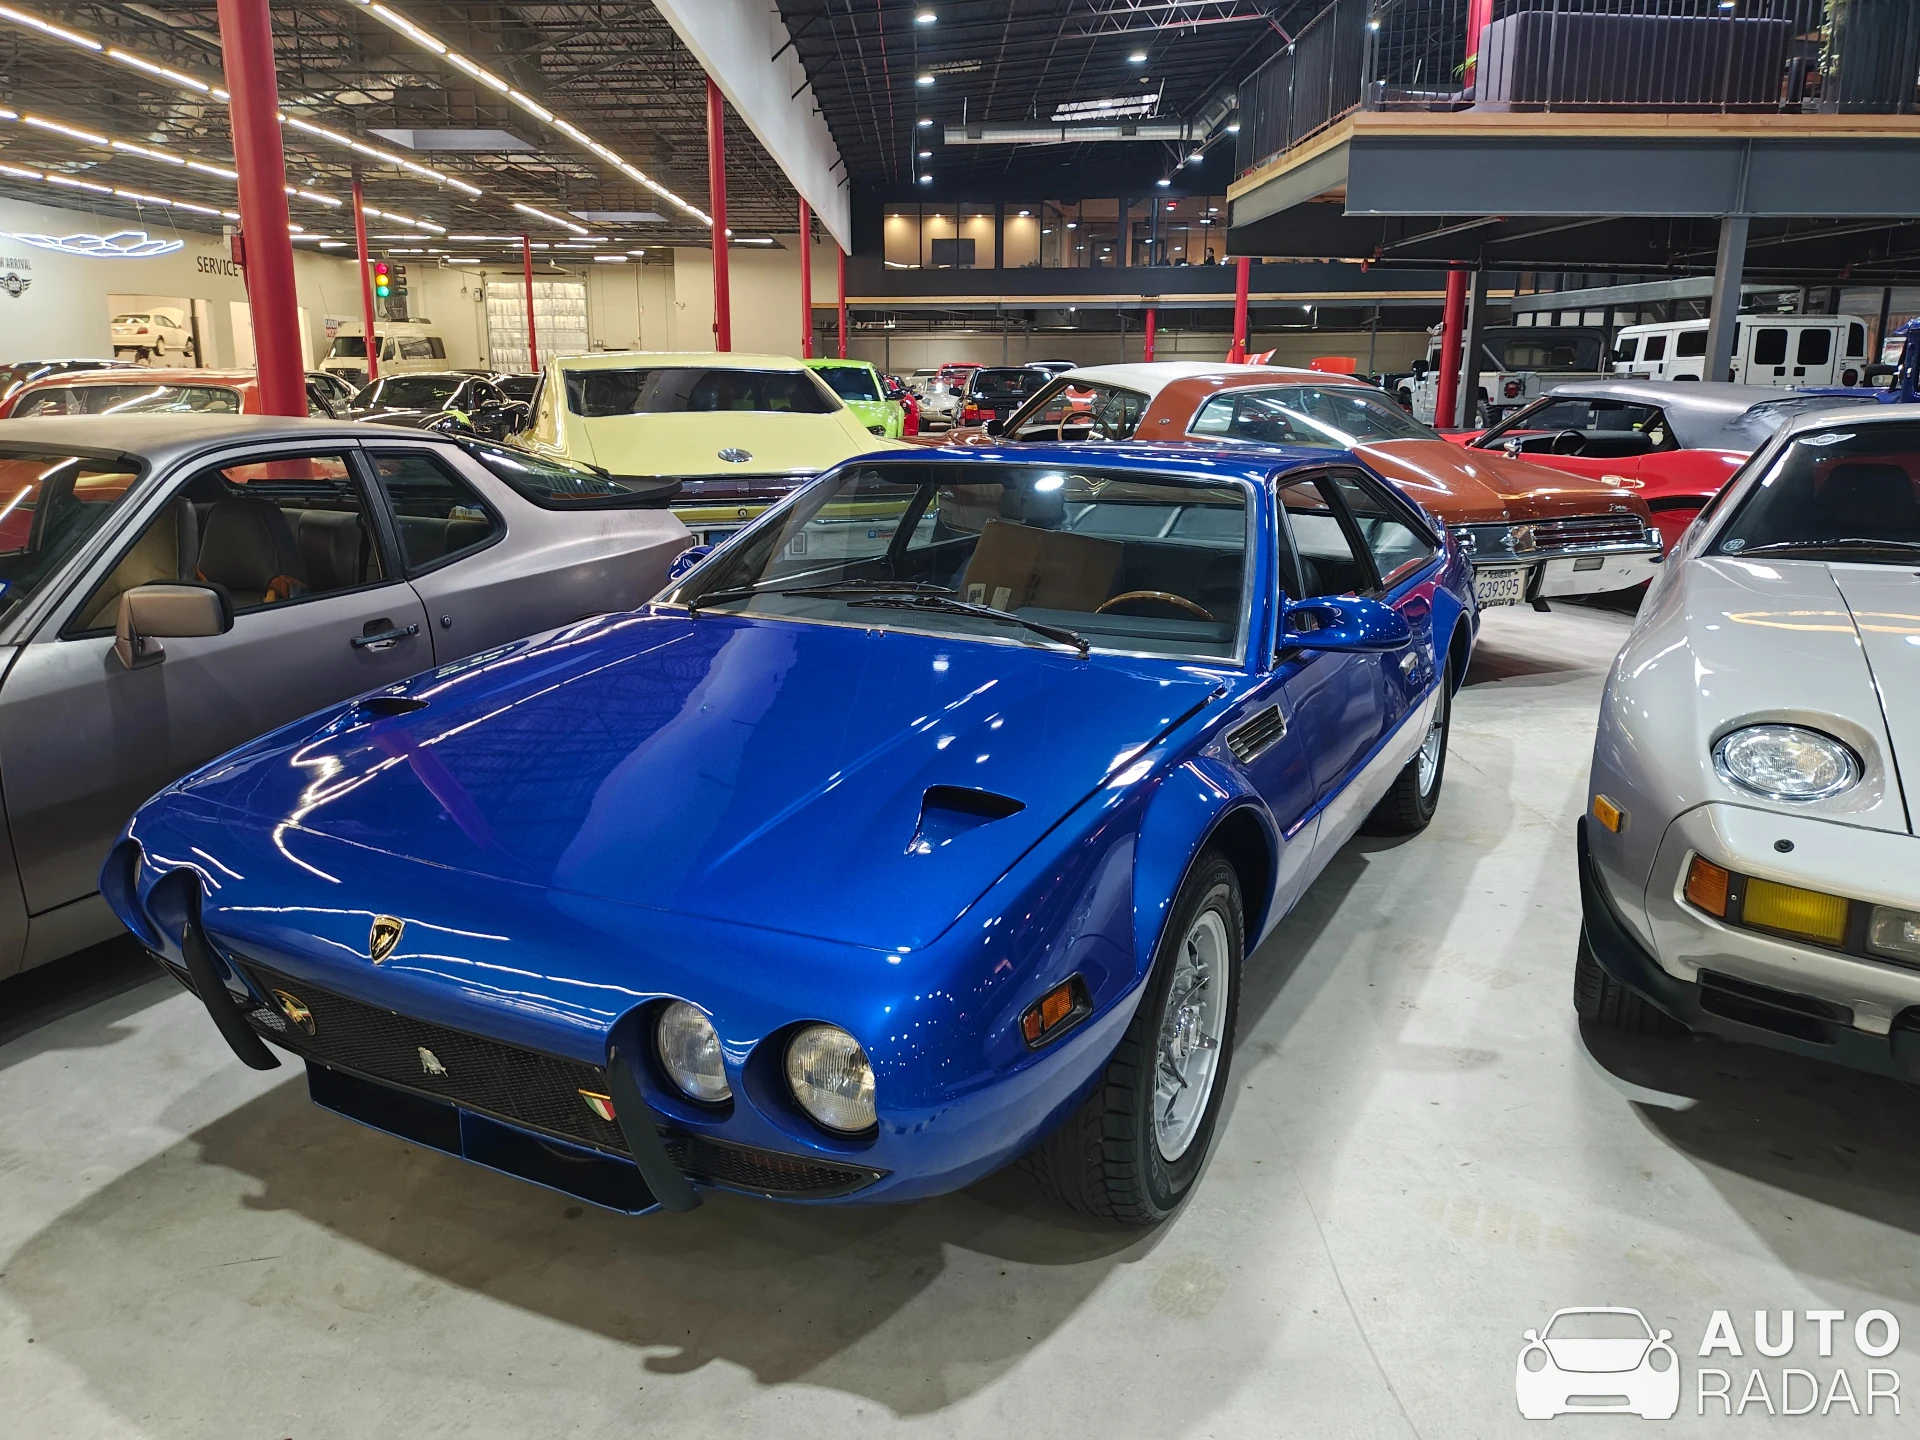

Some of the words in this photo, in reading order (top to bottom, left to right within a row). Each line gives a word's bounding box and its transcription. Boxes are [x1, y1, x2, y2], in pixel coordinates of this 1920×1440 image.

[5, 257, 31, 270] ARRIVAL
[197, 255, 238, 277] SERVICE
[1478, 578, 1519, 599] 239395
